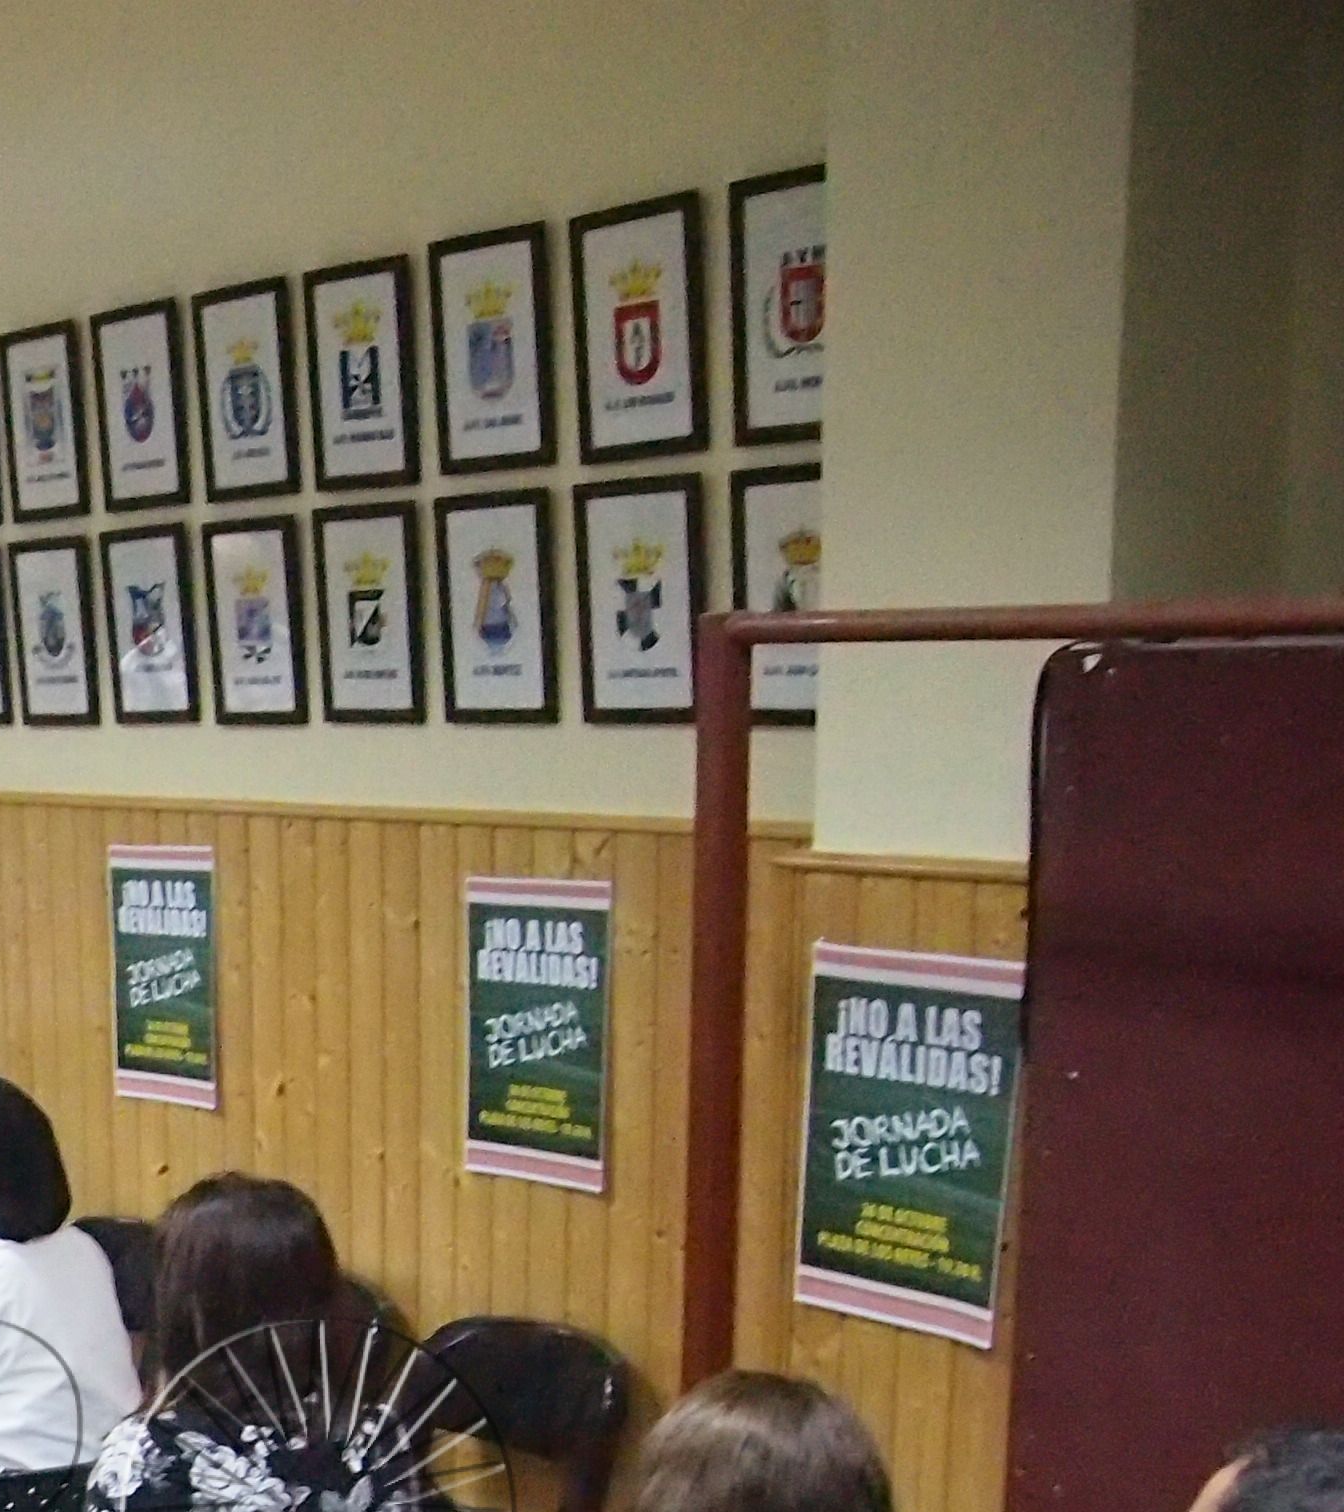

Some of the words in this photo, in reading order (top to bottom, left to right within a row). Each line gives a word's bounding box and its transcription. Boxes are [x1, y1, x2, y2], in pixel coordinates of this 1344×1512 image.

[895, 1002, 917, 1042] A
[925, 1004, 983, 1053] LAS
[488, 1041, 517, 1069] DE
[829, 1106, 971, 1150] JORNADA
[834, 1148, 874, 1181] DE
[879, 1138, 982, 1176] LUCHA
